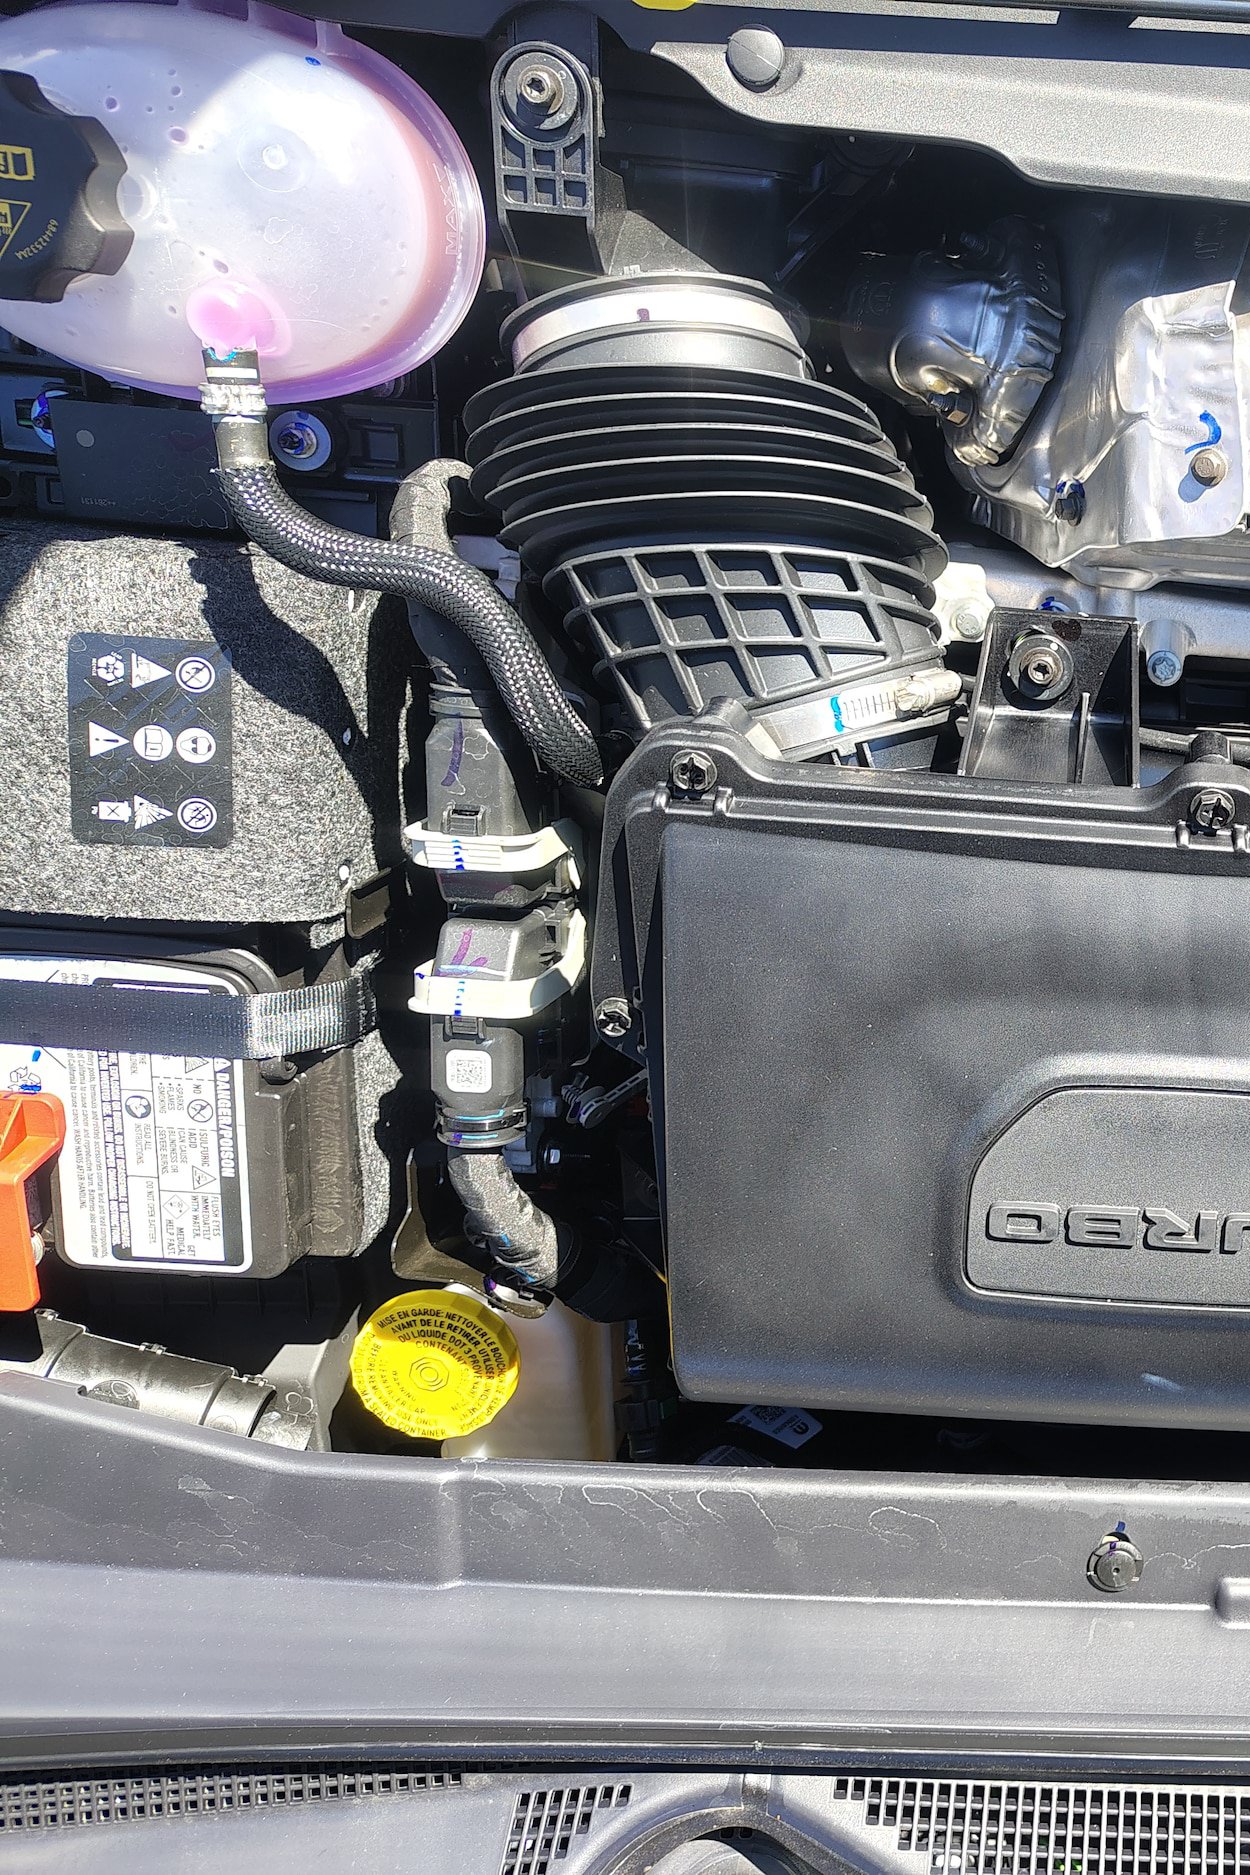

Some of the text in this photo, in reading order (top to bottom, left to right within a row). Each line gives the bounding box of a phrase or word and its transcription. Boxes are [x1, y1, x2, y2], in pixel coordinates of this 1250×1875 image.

[440, 186, 458, 255] MAX
[68, 1059, 76, 1084] California
[78, 1060, 87, 1084] California
[81, 1092, 89, 1108] cause
[90, 1085, 98, 1109] terminals
[158, 1086, 166, 1114] SMOKING
[167, 1086, 175, 1110] FLAMES
[176, 1087, 184, 1111] SPARKS
[193, 1084, 201, 1094] NO
[82, 1110, 90, 1127] cancer
[92, 1121, 100, 1139] related
[216, 1073, 235, 1177] DANGER/POISON
[74, 1128, 82, 1145] WASH
[144, 1123, 152, 1139] READ
[159, 1130, 167, 1152] SEVERE
[188, 1132, 197, 1149] ACID
[75, 1146, 84, 1163] HANDS
[84, 1140, 94, 1172] reproductive
[95, 1141, 103, 1170] accessories
[135, 1123, 144, 1165] INSTRUCTIONS.
[168, 1130, 178, 1173] BLINDNESS OR
[179, 1145, 188, 1164] CAUSE
[199, 1132, 209, 1167] SULFURIC
[77, 1164, 85, 1181] AFTER
[146, 1181, 153, 1190] DO
[89, 1190, 97, 1212] Batteries
[211, 1196, 219, 1217] FLUSH
[166, 1219, 175, 1236] HELP
[191, 1195, 201, 1239] WITH WATER.
[201, 1195, 211, 1240] IMMEDIATELY
[90, 1225, 98, 1244] contain
[176, 1227, 185, 1256] MEDICAL
[187, 1245, 195, 1257] GET
[377, 1314, 396, 1329] MISE
[397, 1311, 410, 1320] EN
[411, 1309, 445, 1318] GARDE:
[446, 1312, 488, 1339] NETTOYER
[484, 1337, 494, 1347] LE
[398, 1333, 411, 1342] DU
[413, 1329, 447, 1340] LIQUIDE
[450, 1335, 467, 1350] DOT
[391, 1319, 417, 1334] AVANT
[420, 1319, 432, 1327] DE
[434, 1319, 445, 1328] LE
[447, 1323, 479, 1349] RETIRER.
[478, 1348, 495, 1380] UTILISER
[416, 1341, 468, 1366] CONTENANT
[369, 1403, 398, 1427] SEALED
